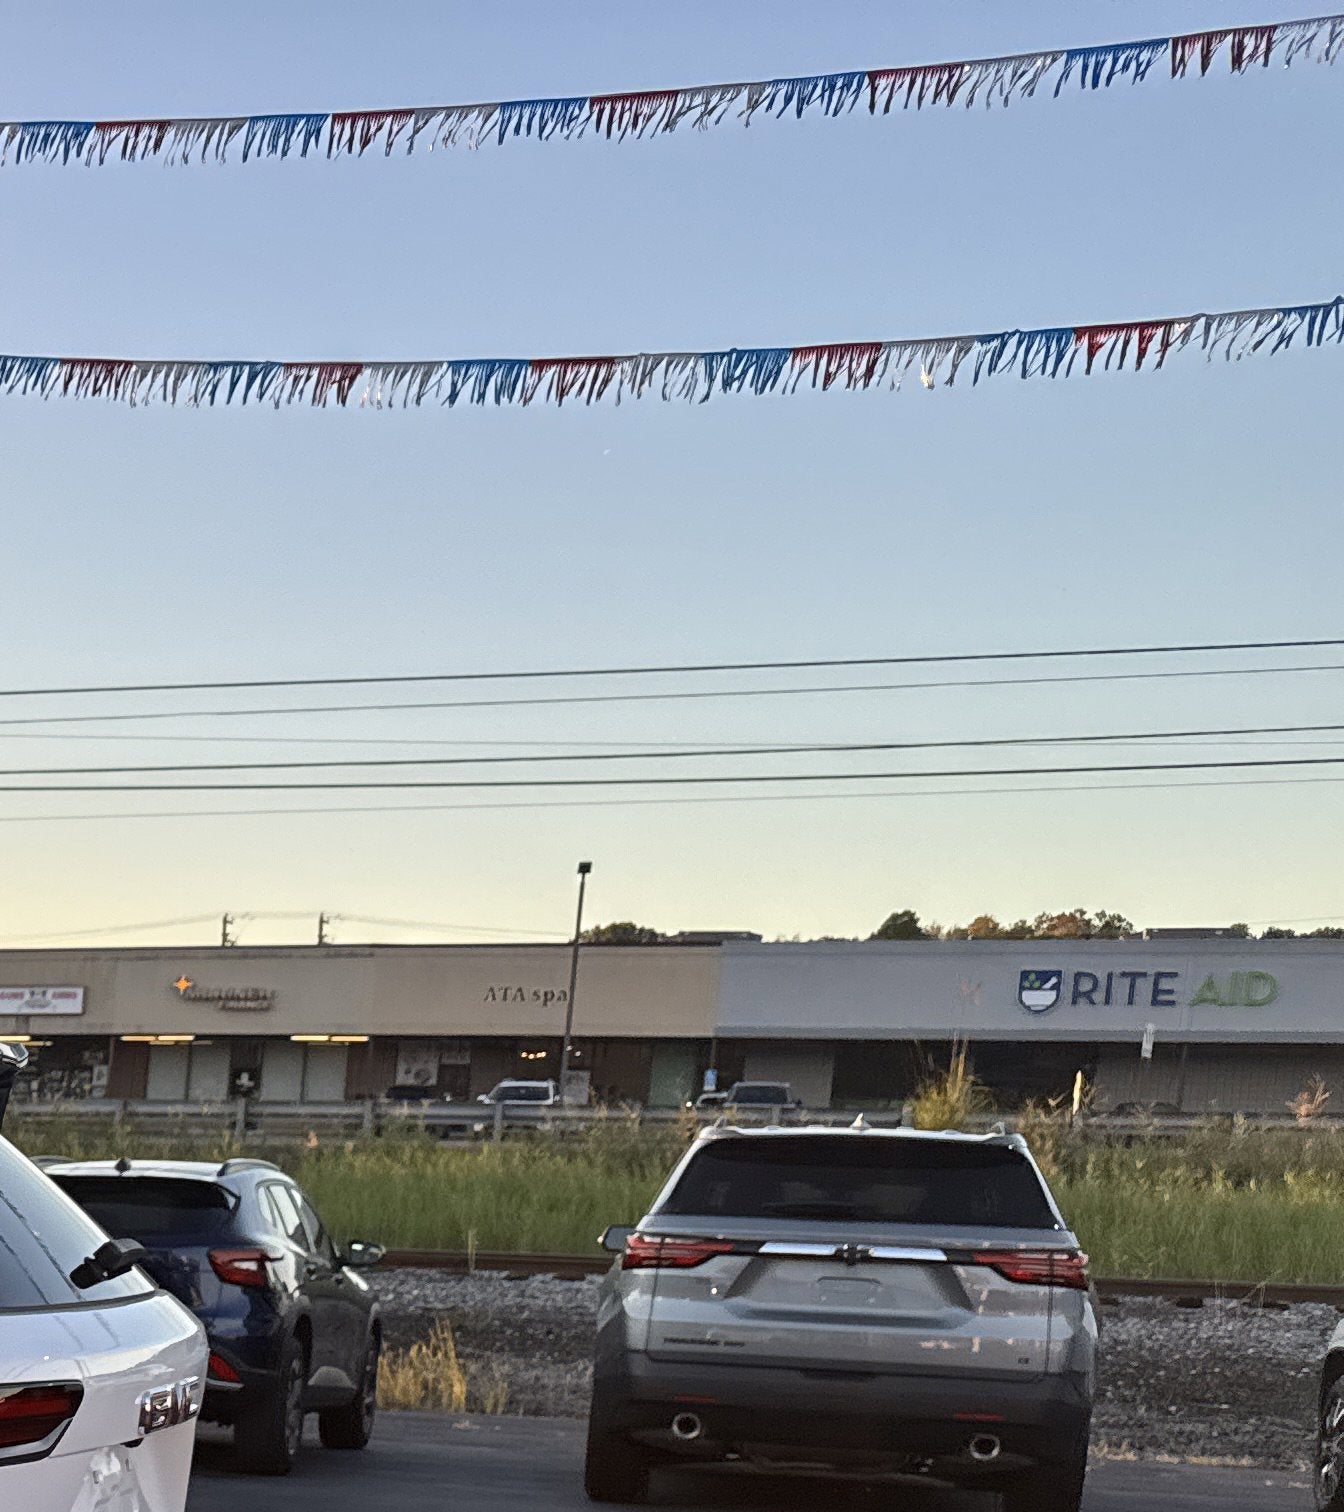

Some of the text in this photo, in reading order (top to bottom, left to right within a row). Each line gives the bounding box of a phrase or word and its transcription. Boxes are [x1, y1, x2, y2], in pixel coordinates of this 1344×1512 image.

[532, 988, 569, 1008] spa
[1070, 970, 1280, 1008] RITE AID
